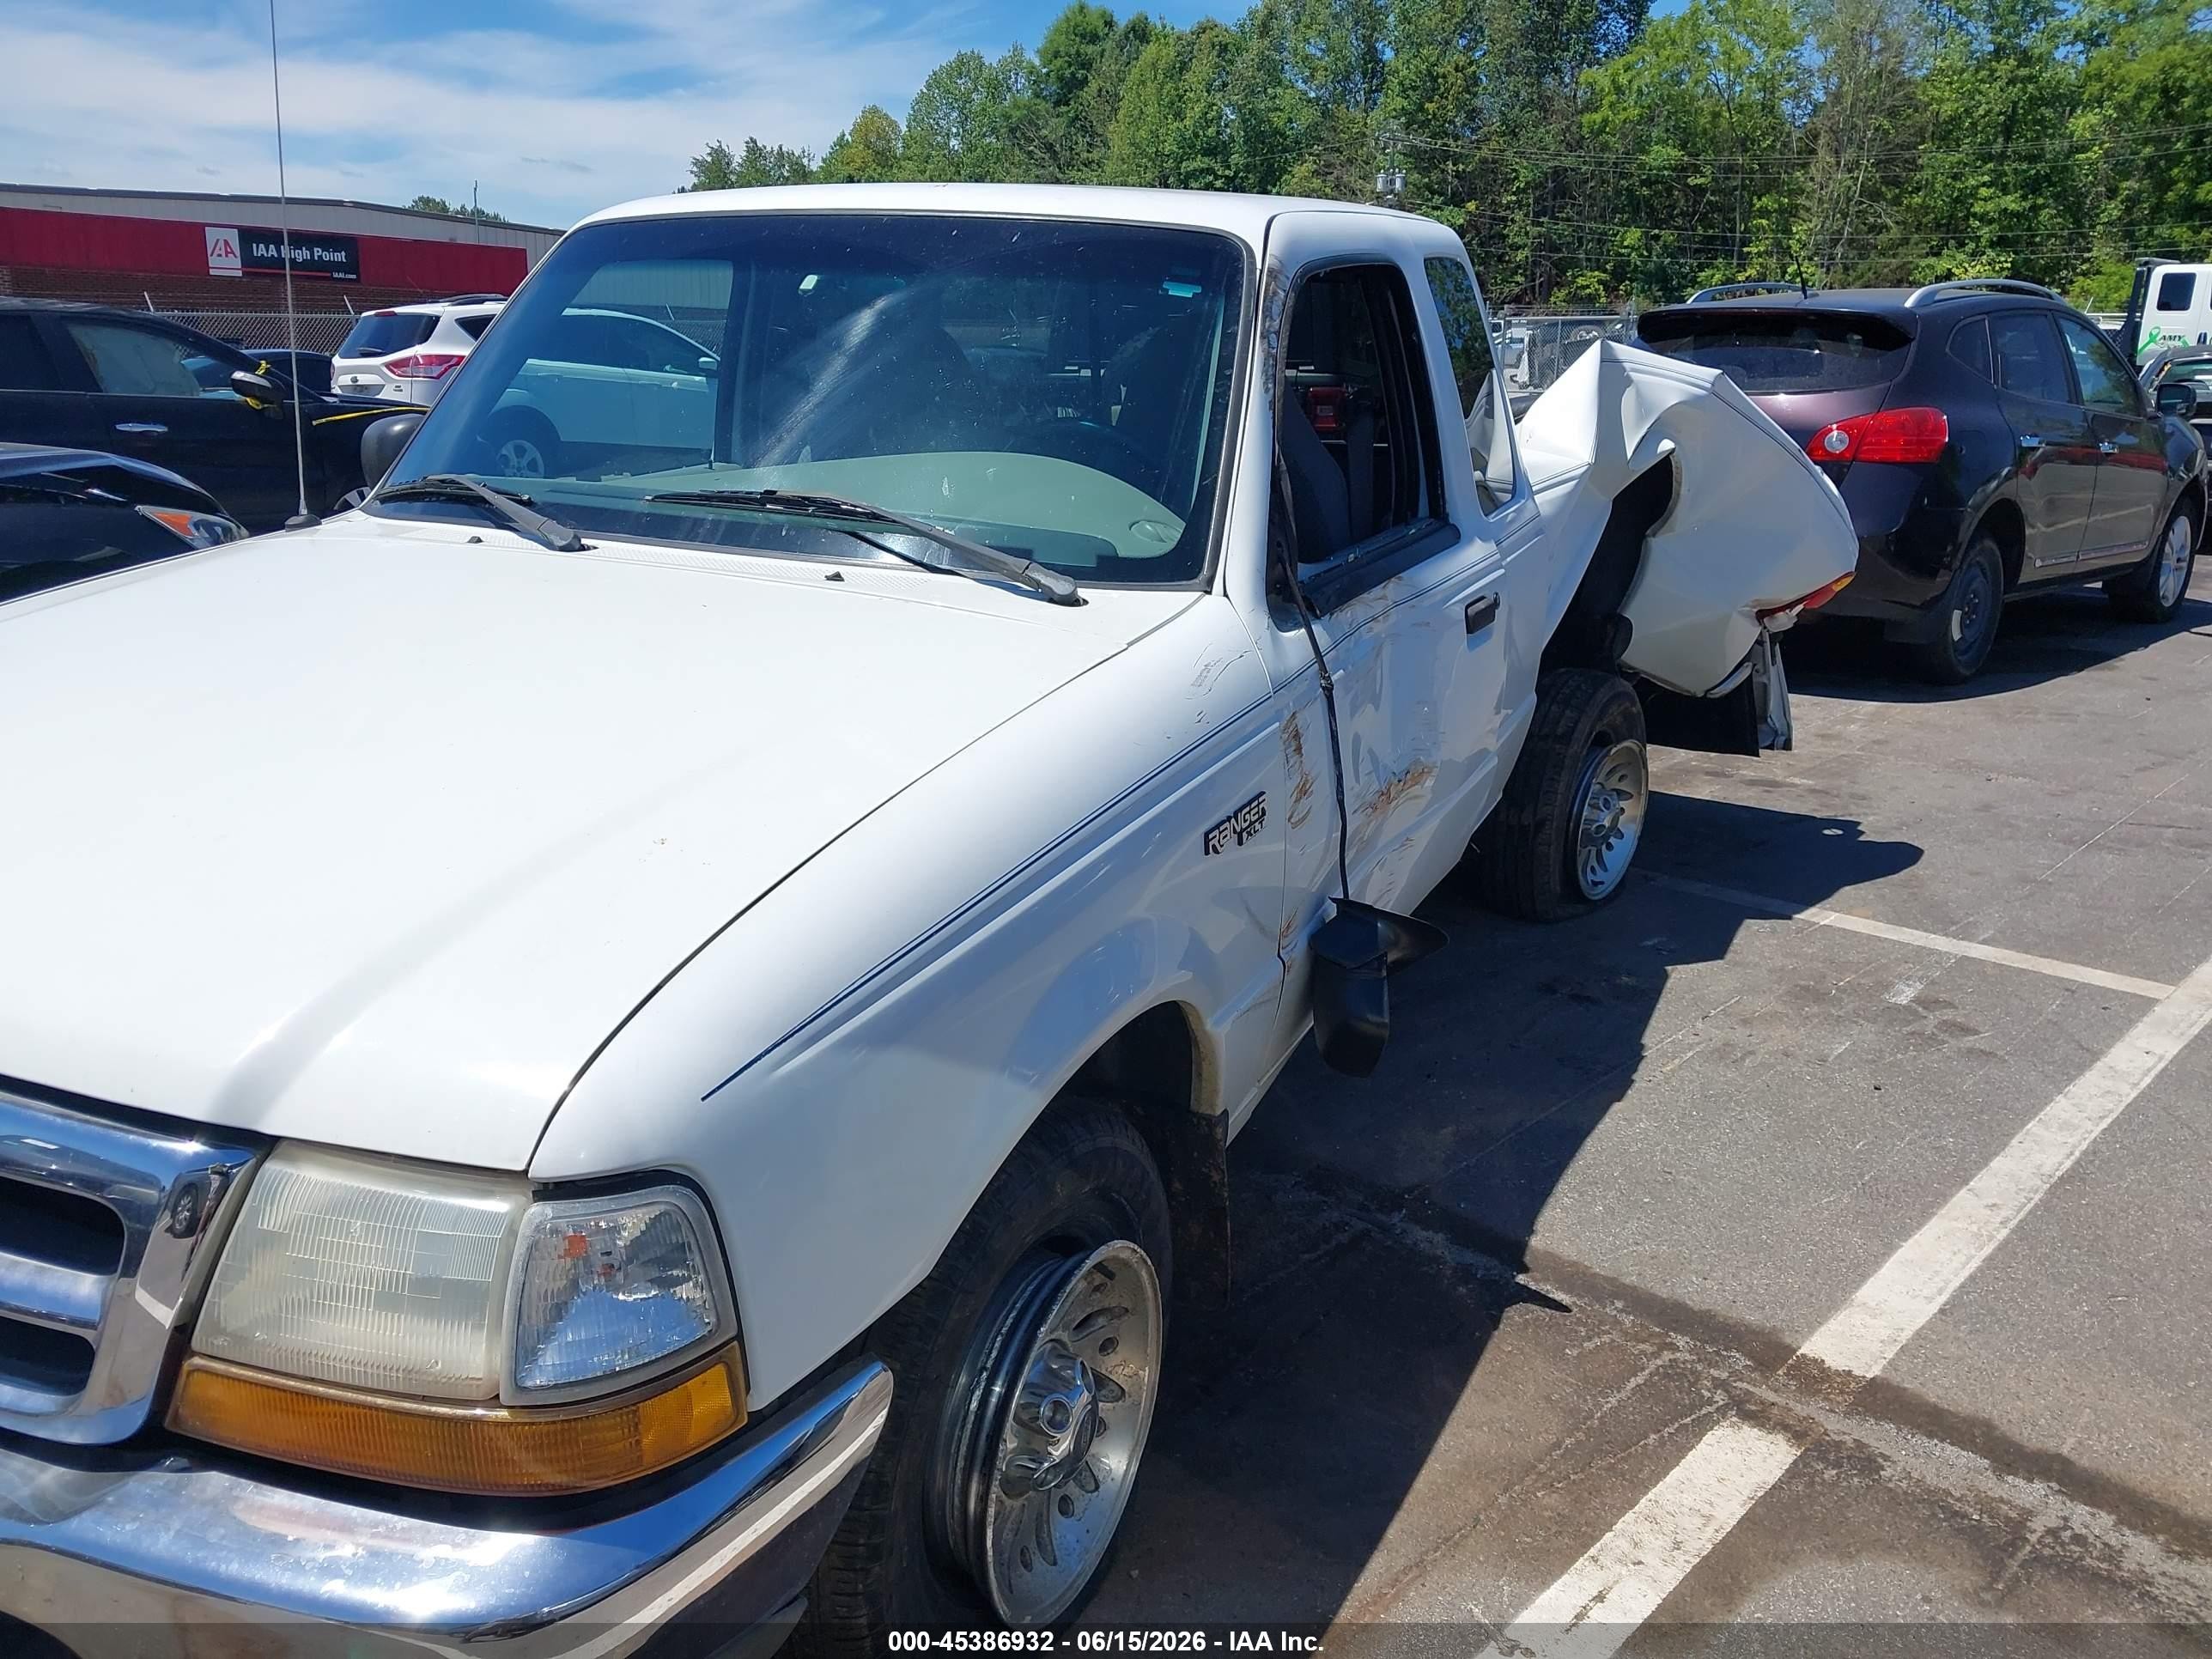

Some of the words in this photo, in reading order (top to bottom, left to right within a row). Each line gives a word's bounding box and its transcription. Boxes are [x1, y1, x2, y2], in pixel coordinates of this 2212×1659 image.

[252, 242, 278, 258] IAA
[280, 245, 311, 263] High
[313, 246, 347, 263] Point
[1245, 817, 1266, 842] XLT
